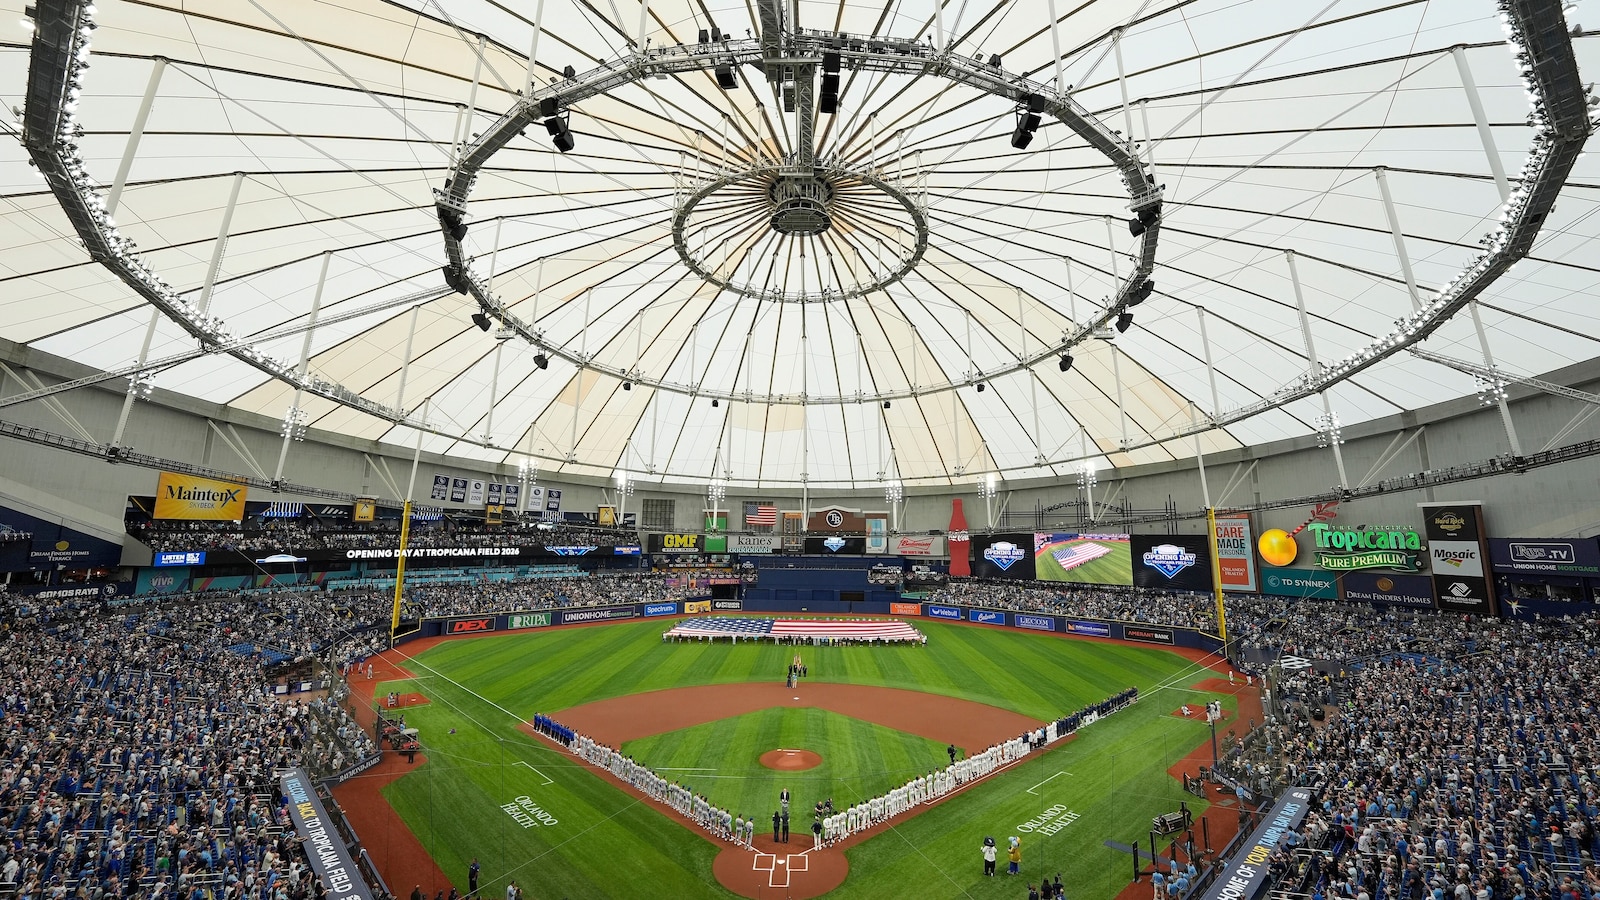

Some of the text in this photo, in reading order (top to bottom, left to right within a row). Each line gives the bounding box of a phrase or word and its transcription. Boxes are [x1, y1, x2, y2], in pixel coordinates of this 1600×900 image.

[165, 485, 241, 508] MaintenX
[1216, 527, 1244, 538] CARE
[1308, 523, 1421, 551] Tropicana
[664, 534, 698, 548] GMF
[1217, 538, 1246, 549] MADE
[346, 550, 393, 559] OPENING
[413, 549, 425, 557] AT
[426, 548, 477, 557] TROPICANA
[478, 547, 501, 556] FIELD
[501, 547, 520, 556] 2026
[1434, 549, 1476, 559] Mosaic
[1322, 555, 1407, 568] PURE PREMIUM
[1281, 578, 1331, 588] TD SYNNEX
[39, 588, 99, 599] SOMOS RAYS
[1346, 591, 1432, 604] DREAM FINDERS HOMES
[648, 605, 672, 613] Spectrum
[941, 608, 958, 617] Webull
[453, 619, 490, 632] DEX
[522, 614, 548, 627] RIPA
[1020, 616, 1049, 626] LECOM
[296, 801, 318, 820] BACK
[500, 802, 540, 829] HEALTH
[514, 795, 559, 826] ORLANDO
[1282, 801, 1302, 819] RAYS
[303, 817, 322, 829] TO
[1016, 804, 1067, 833] ORLANDO
[1036, 809, 1082, 837] HEALTH
[1273, 812, 1292, 830] BAY
[1257, 826, 1281, 848] TAMPA
[308, 827, 342, 871] TROPICANA
[1244, 845, 1272, 867] YOUR
[1236, 864, 1258, 878] OF
[326, 866, 353, 893] FIELD
